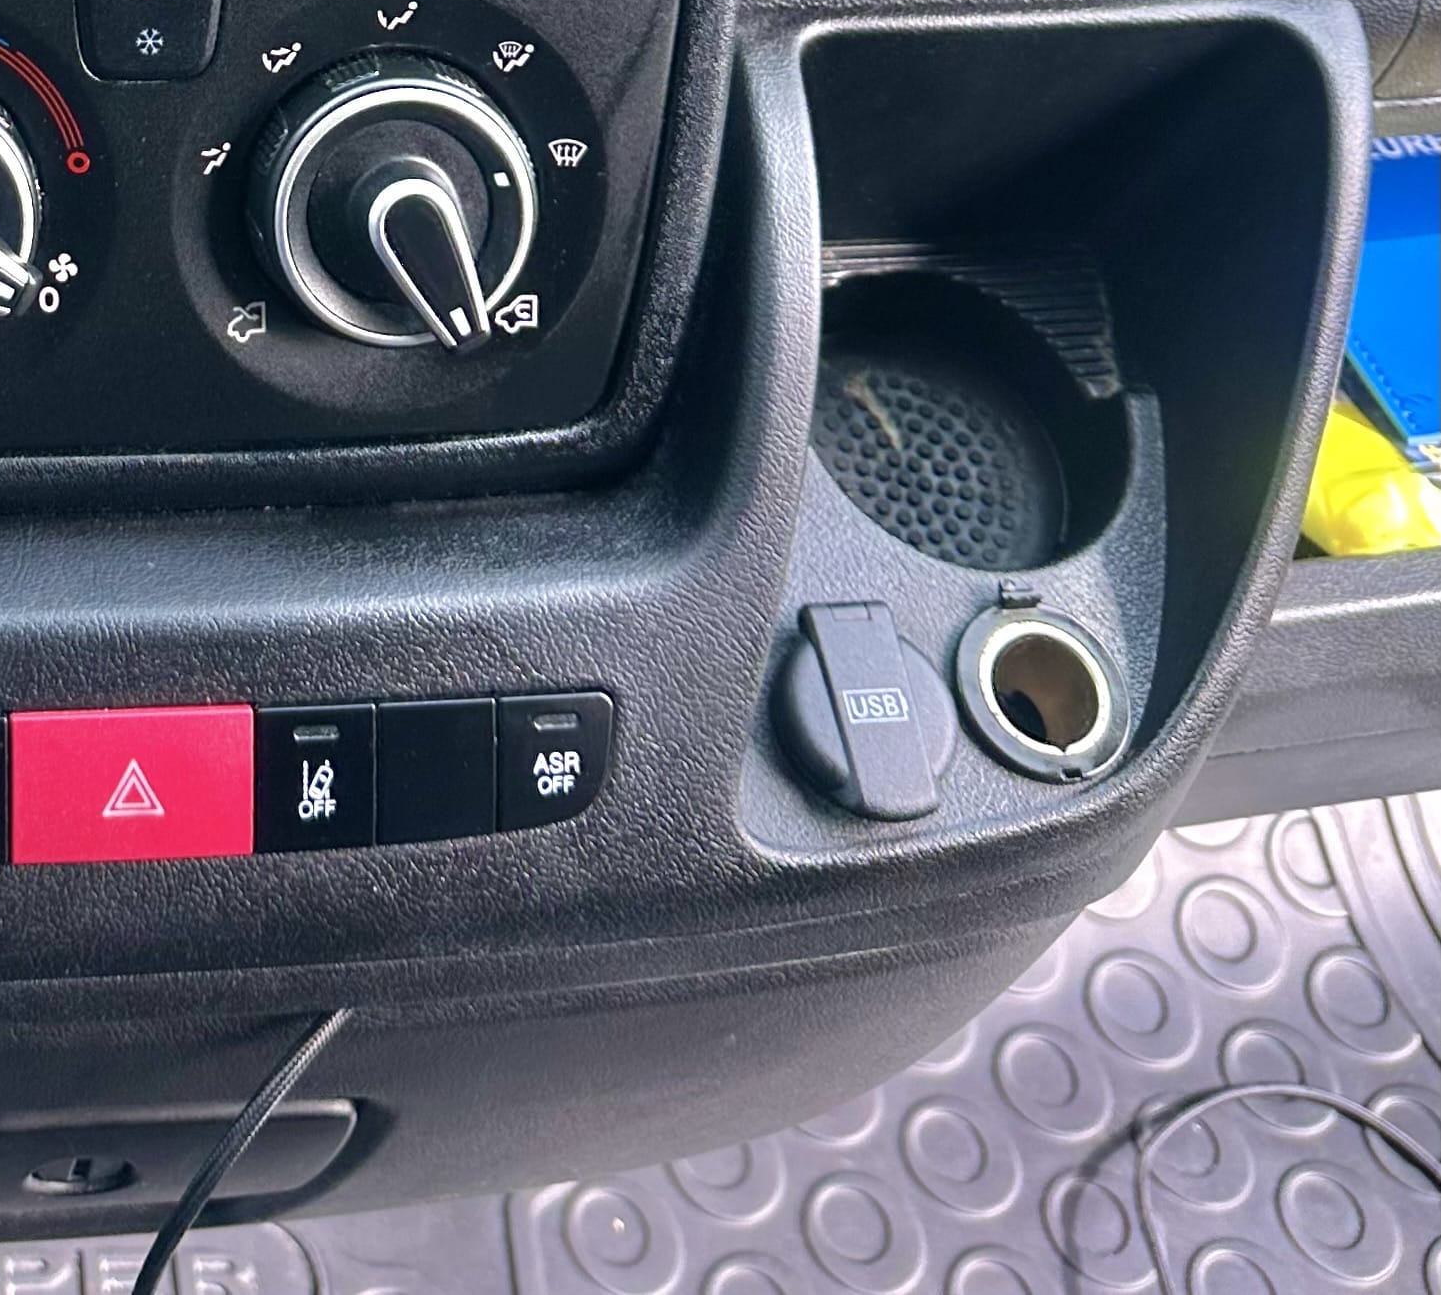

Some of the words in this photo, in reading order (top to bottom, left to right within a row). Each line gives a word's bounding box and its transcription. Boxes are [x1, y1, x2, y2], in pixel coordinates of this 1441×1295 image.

[39, 287, 59, 313] 0
[850, 693, 899, 718] USB
[533, 751, 581, 775] ASR
[537, 774, 575, 796] OFF
[298, 799, 337, 820] OFF
